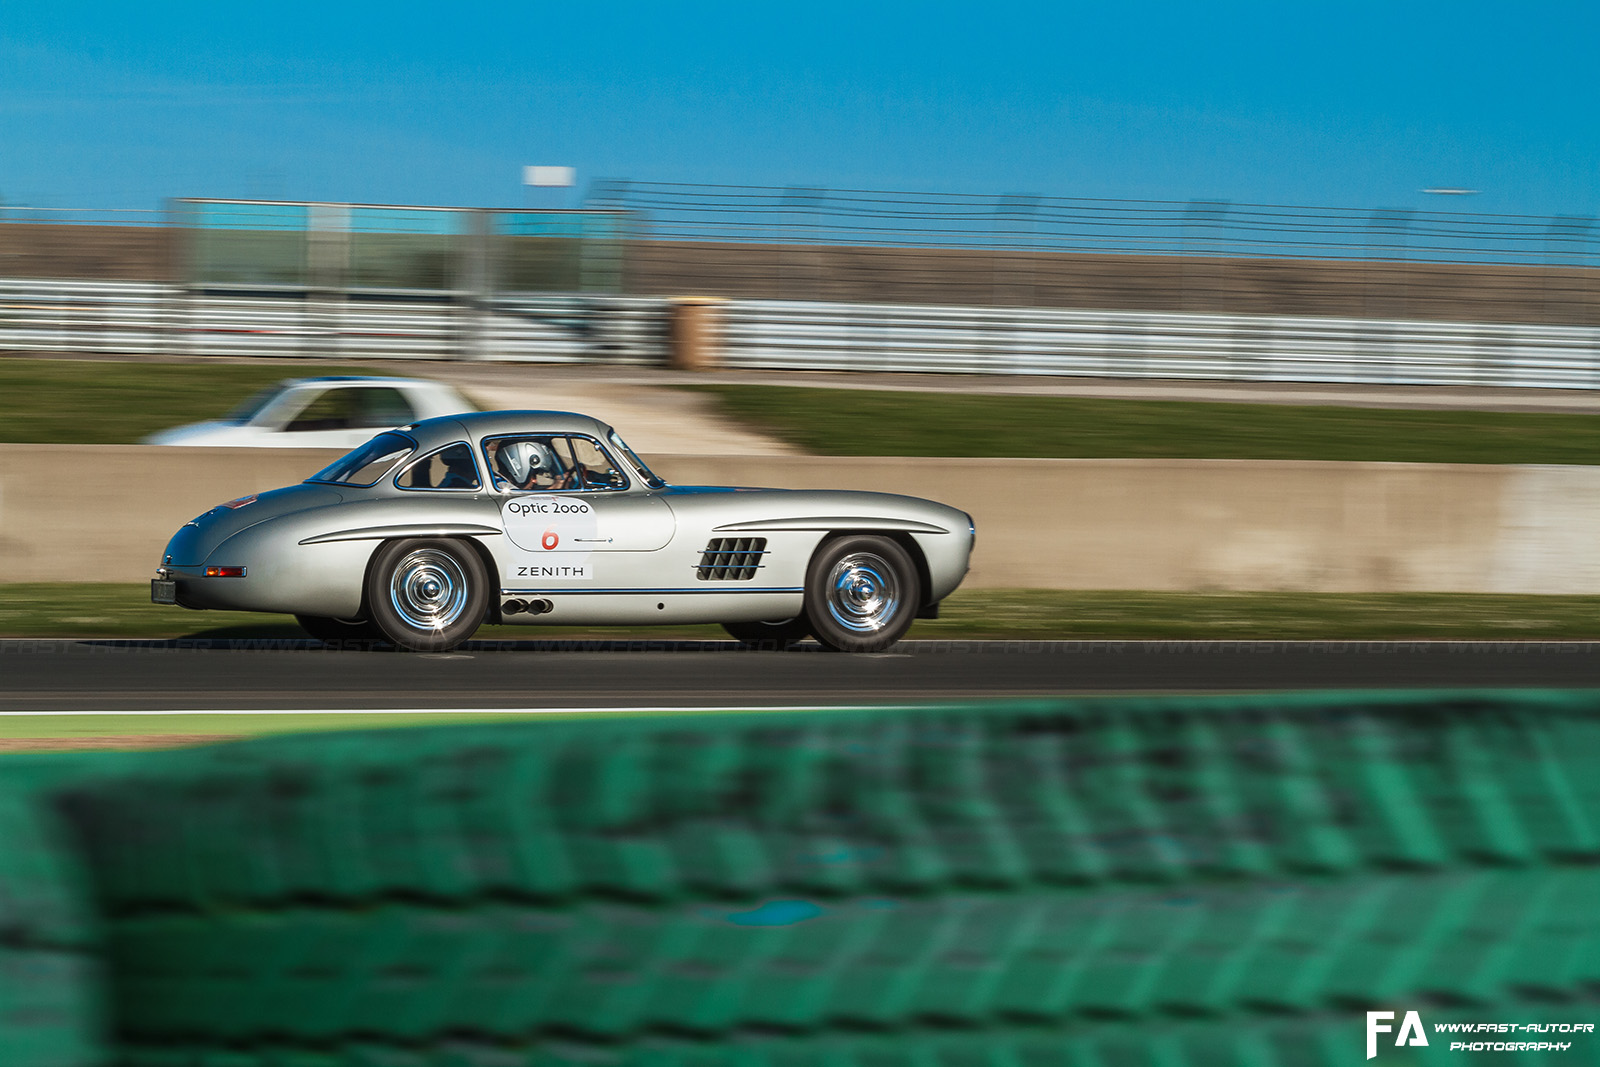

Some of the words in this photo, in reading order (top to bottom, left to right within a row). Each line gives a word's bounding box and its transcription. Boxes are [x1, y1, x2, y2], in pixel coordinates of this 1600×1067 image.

[508, 502, 549, 517] Optic
[552, 502, 589, 514] 2000
[517, 566, 584, 577] ZENITH
